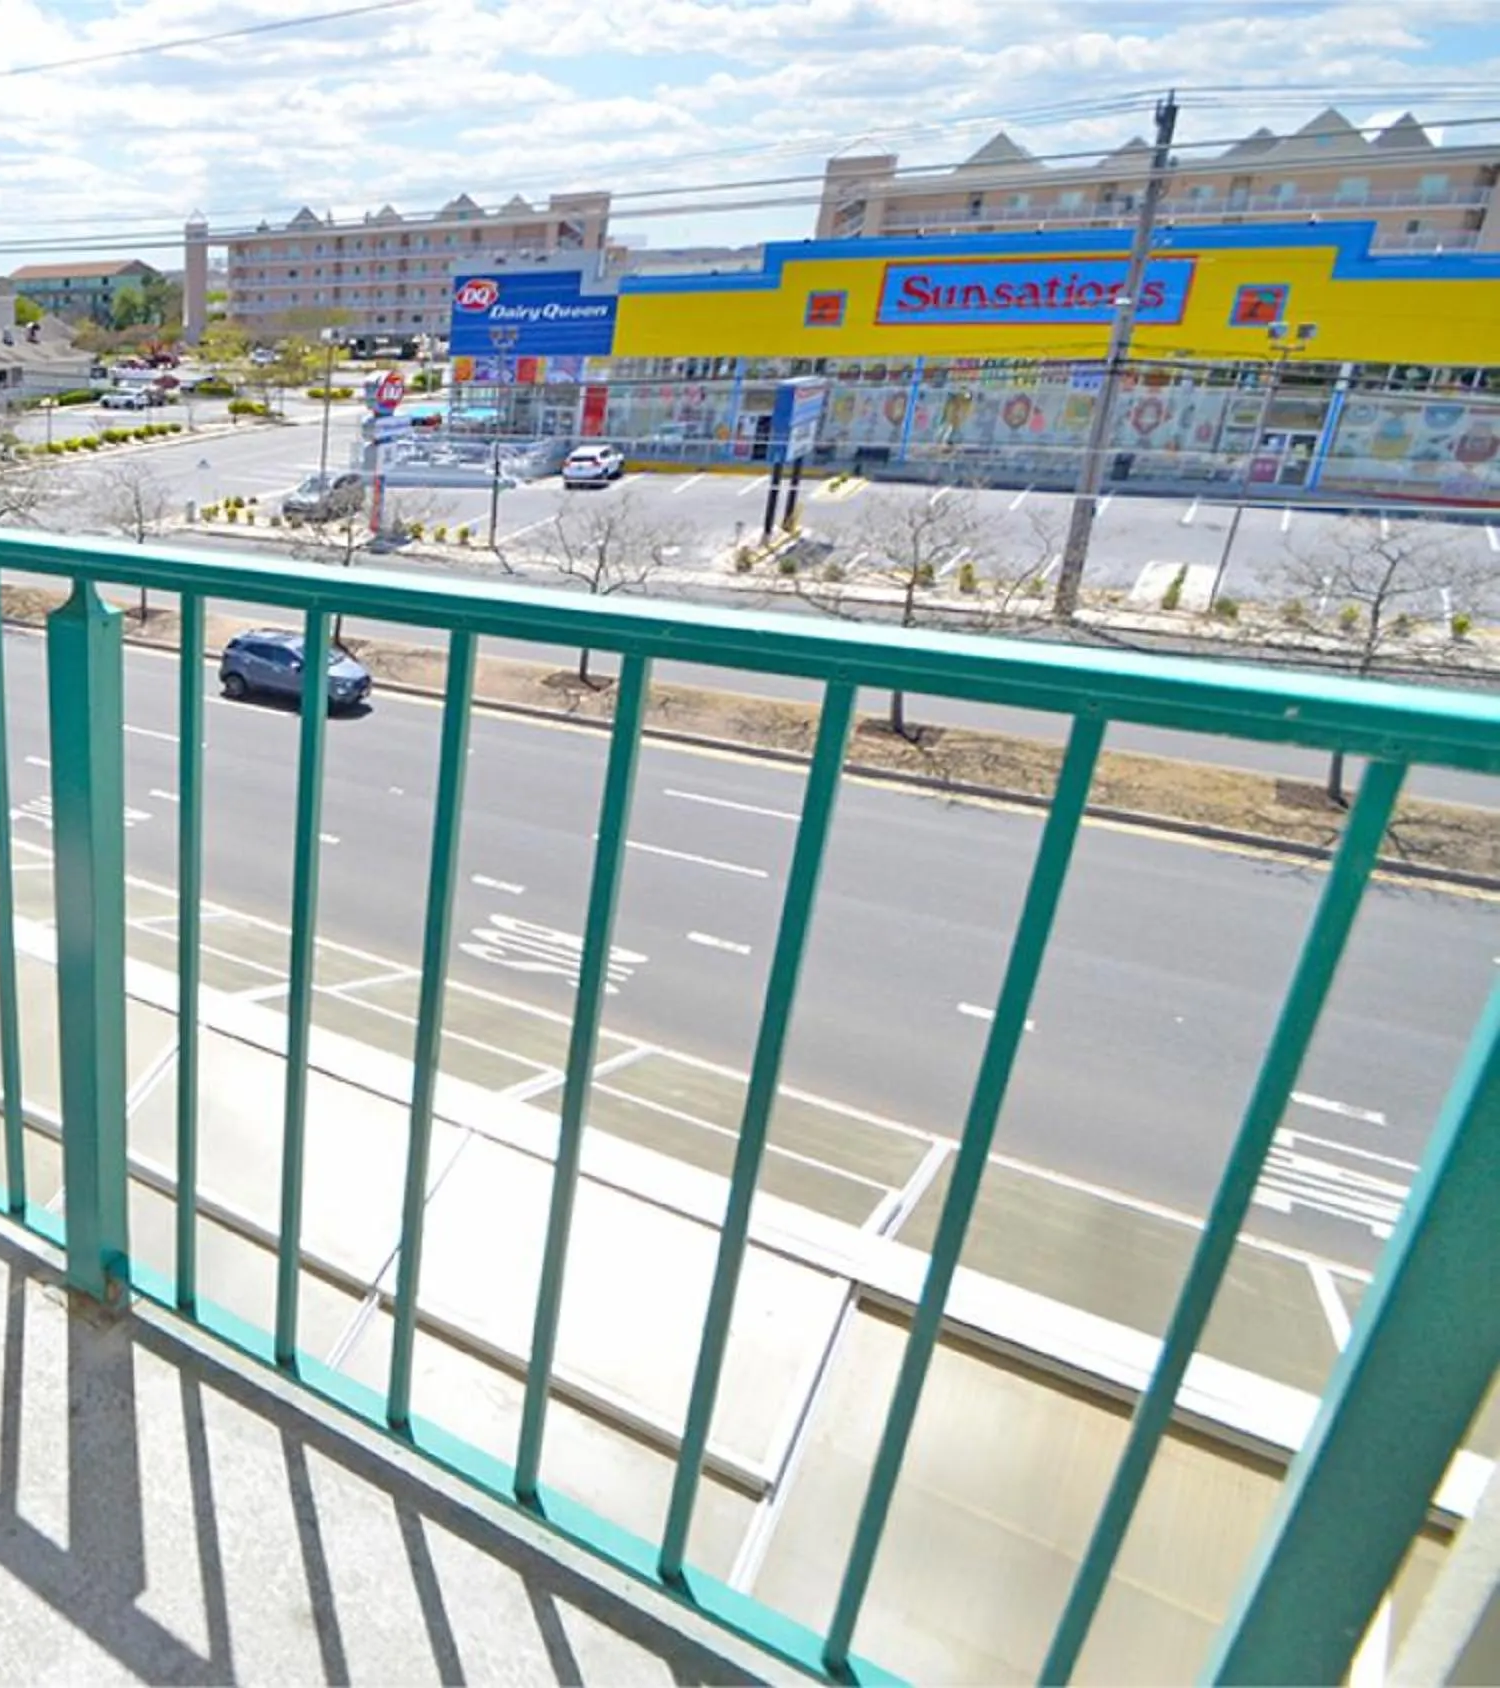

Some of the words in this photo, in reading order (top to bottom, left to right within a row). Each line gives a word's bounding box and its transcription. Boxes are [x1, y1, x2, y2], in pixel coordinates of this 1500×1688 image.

[462, 287, 490, 304] DQ
[489, 304, 541, 321] Dairy
[542, 303, 609, 319] Queen
